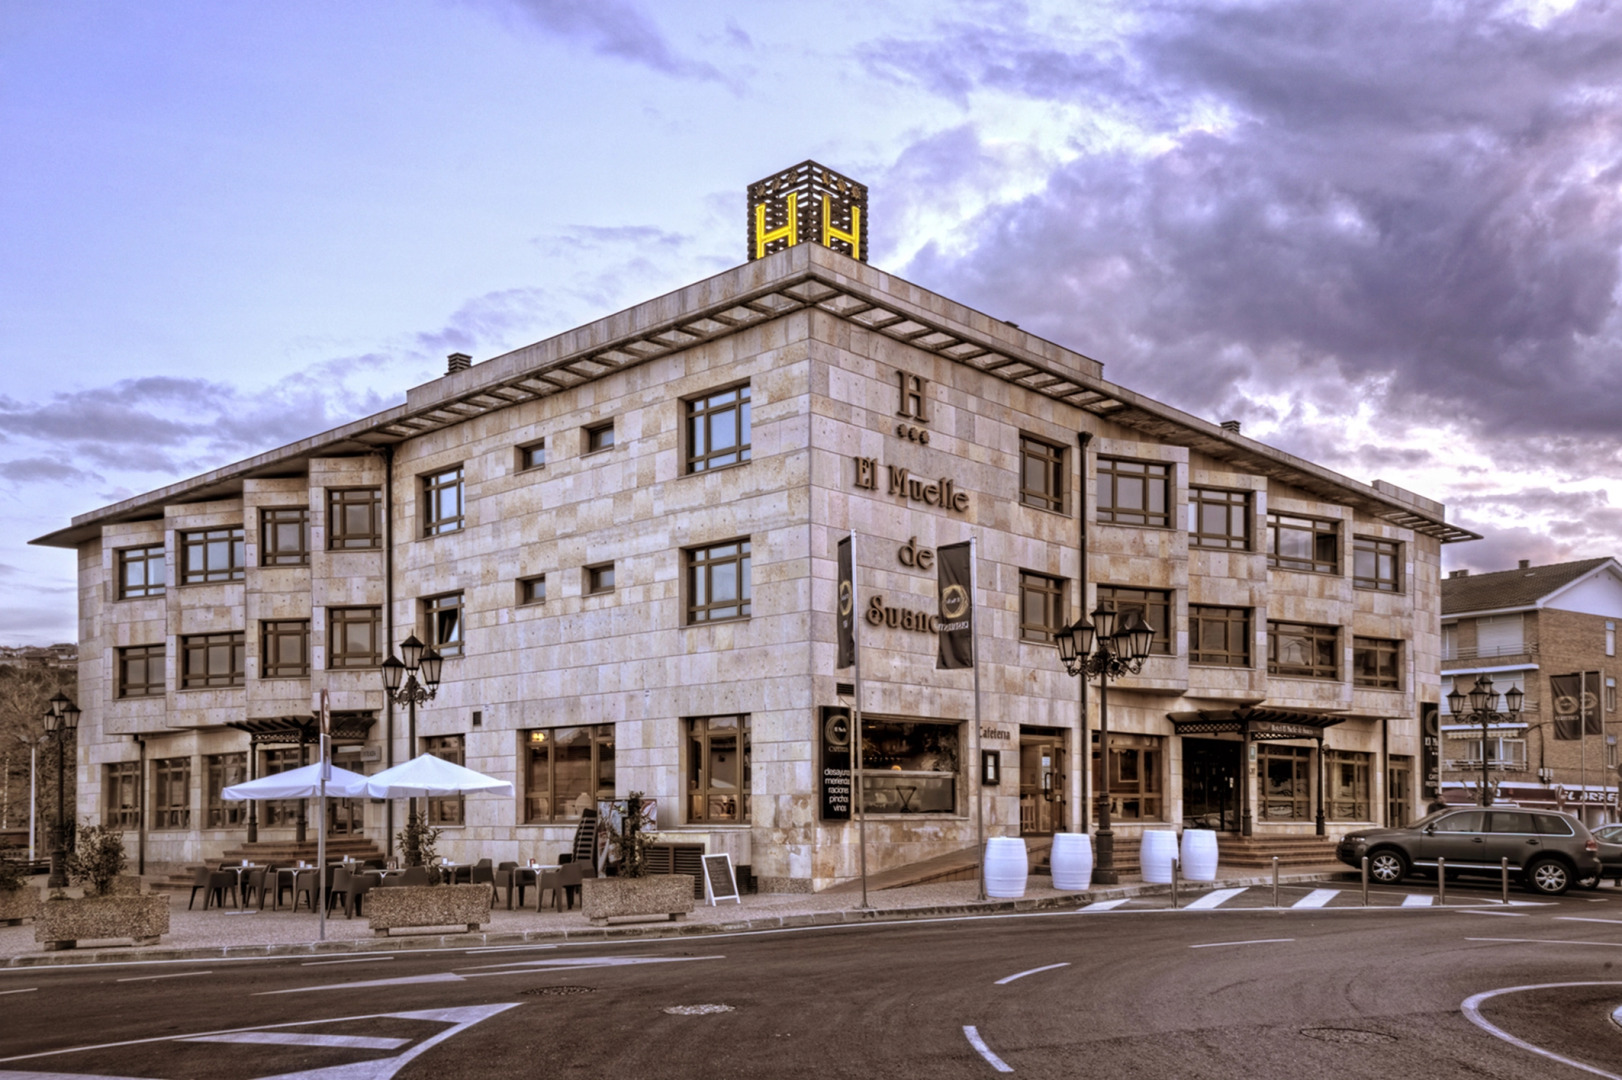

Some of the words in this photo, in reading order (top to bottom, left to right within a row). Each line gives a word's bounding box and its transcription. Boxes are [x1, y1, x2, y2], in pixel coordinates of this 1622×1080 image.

[756, 192, 797, 260] H
[822, 193, 860, 260] H
[895, 369, 930, 423] H
[854, 456, 878, 491] El
[887, 465, 970, 513] Muelle
[898, 536, 934, 570] de
[866, 595, 940, 635] Suanc
